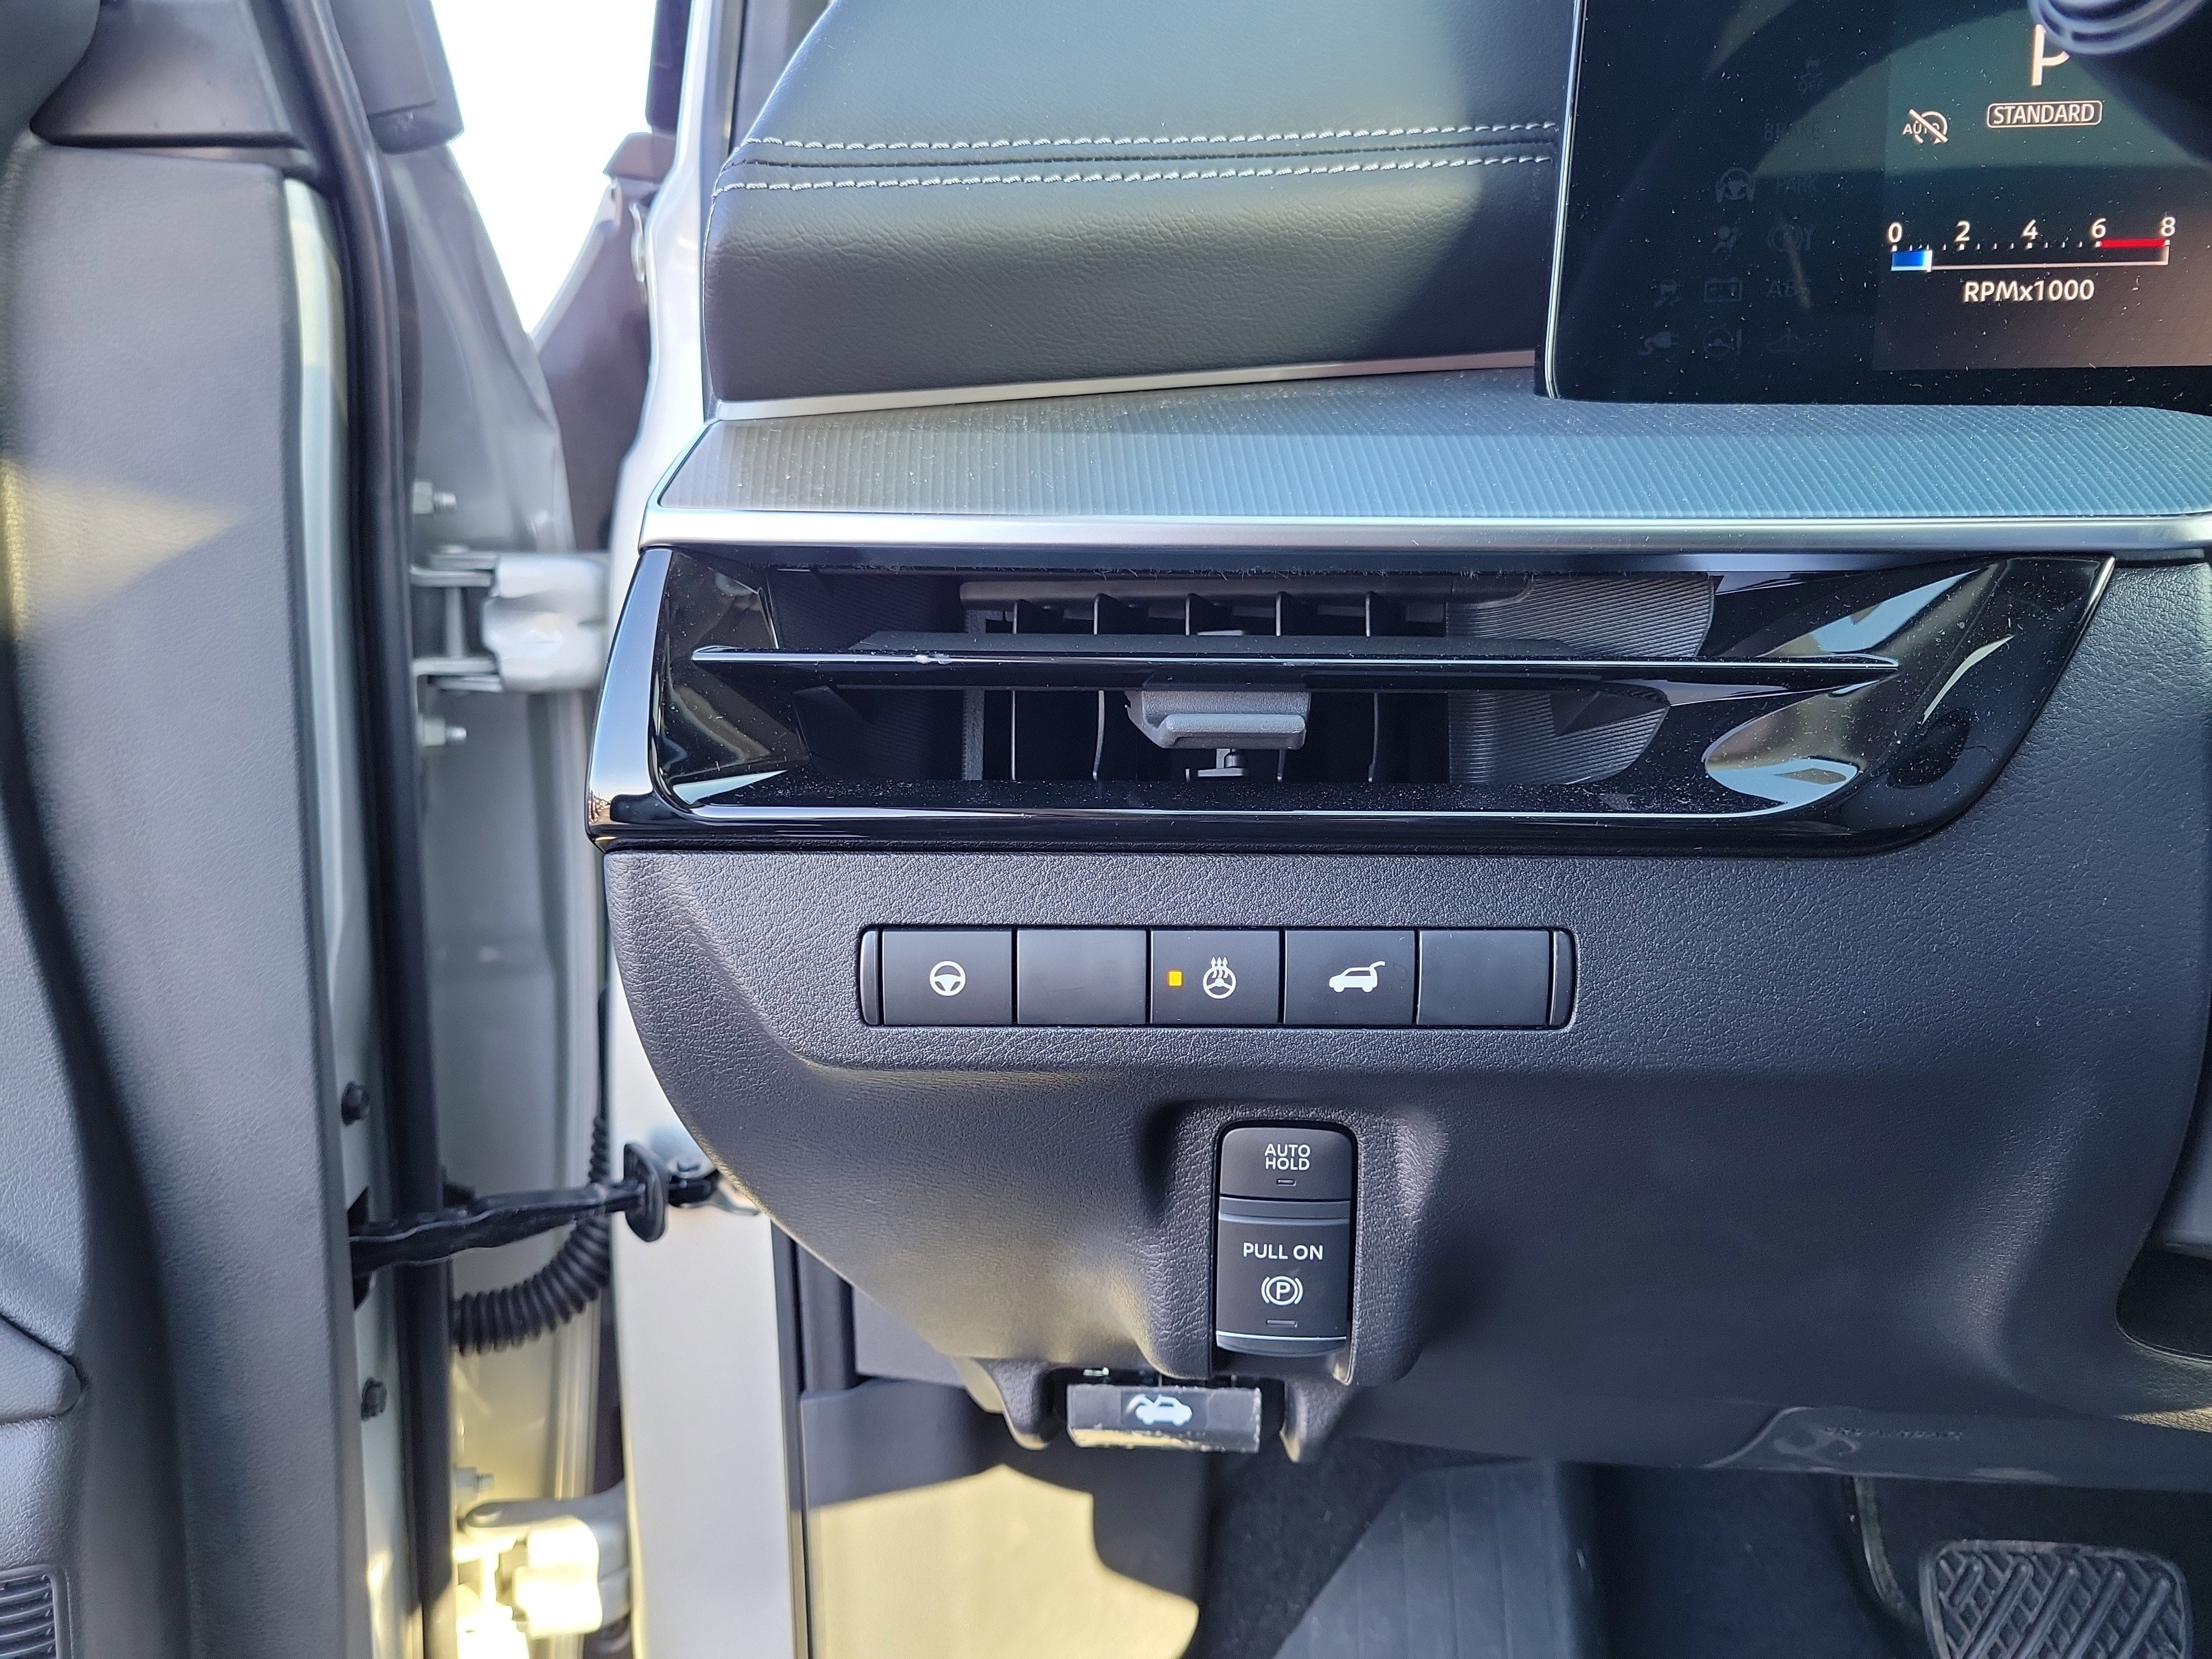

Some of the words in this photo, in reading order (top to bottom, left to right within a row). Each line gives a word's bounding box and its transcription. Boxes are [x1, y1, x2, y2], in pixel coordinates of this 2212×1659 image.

[1993, 103, 2095, 125] STANDARD
[1888, 222, 1902, 243] 0
[1955, 221, 1971, 241] 2
[2022, 219, 2038, 240] 4
[2091, 218, 2106, 238] 6
[2160, 217, 2175, 236] 8
[1963, 279, 2095, 302] RPMx1000
[1265, 1143, 1311, 1158] AUTO
[1265, 1157, 1310, 1171] HOLD
[1243, 1242, 1288, 1260] PULL
[1293, 1245, 1323, 1260] ON
[1276, 1282, 1290, 1300] P
